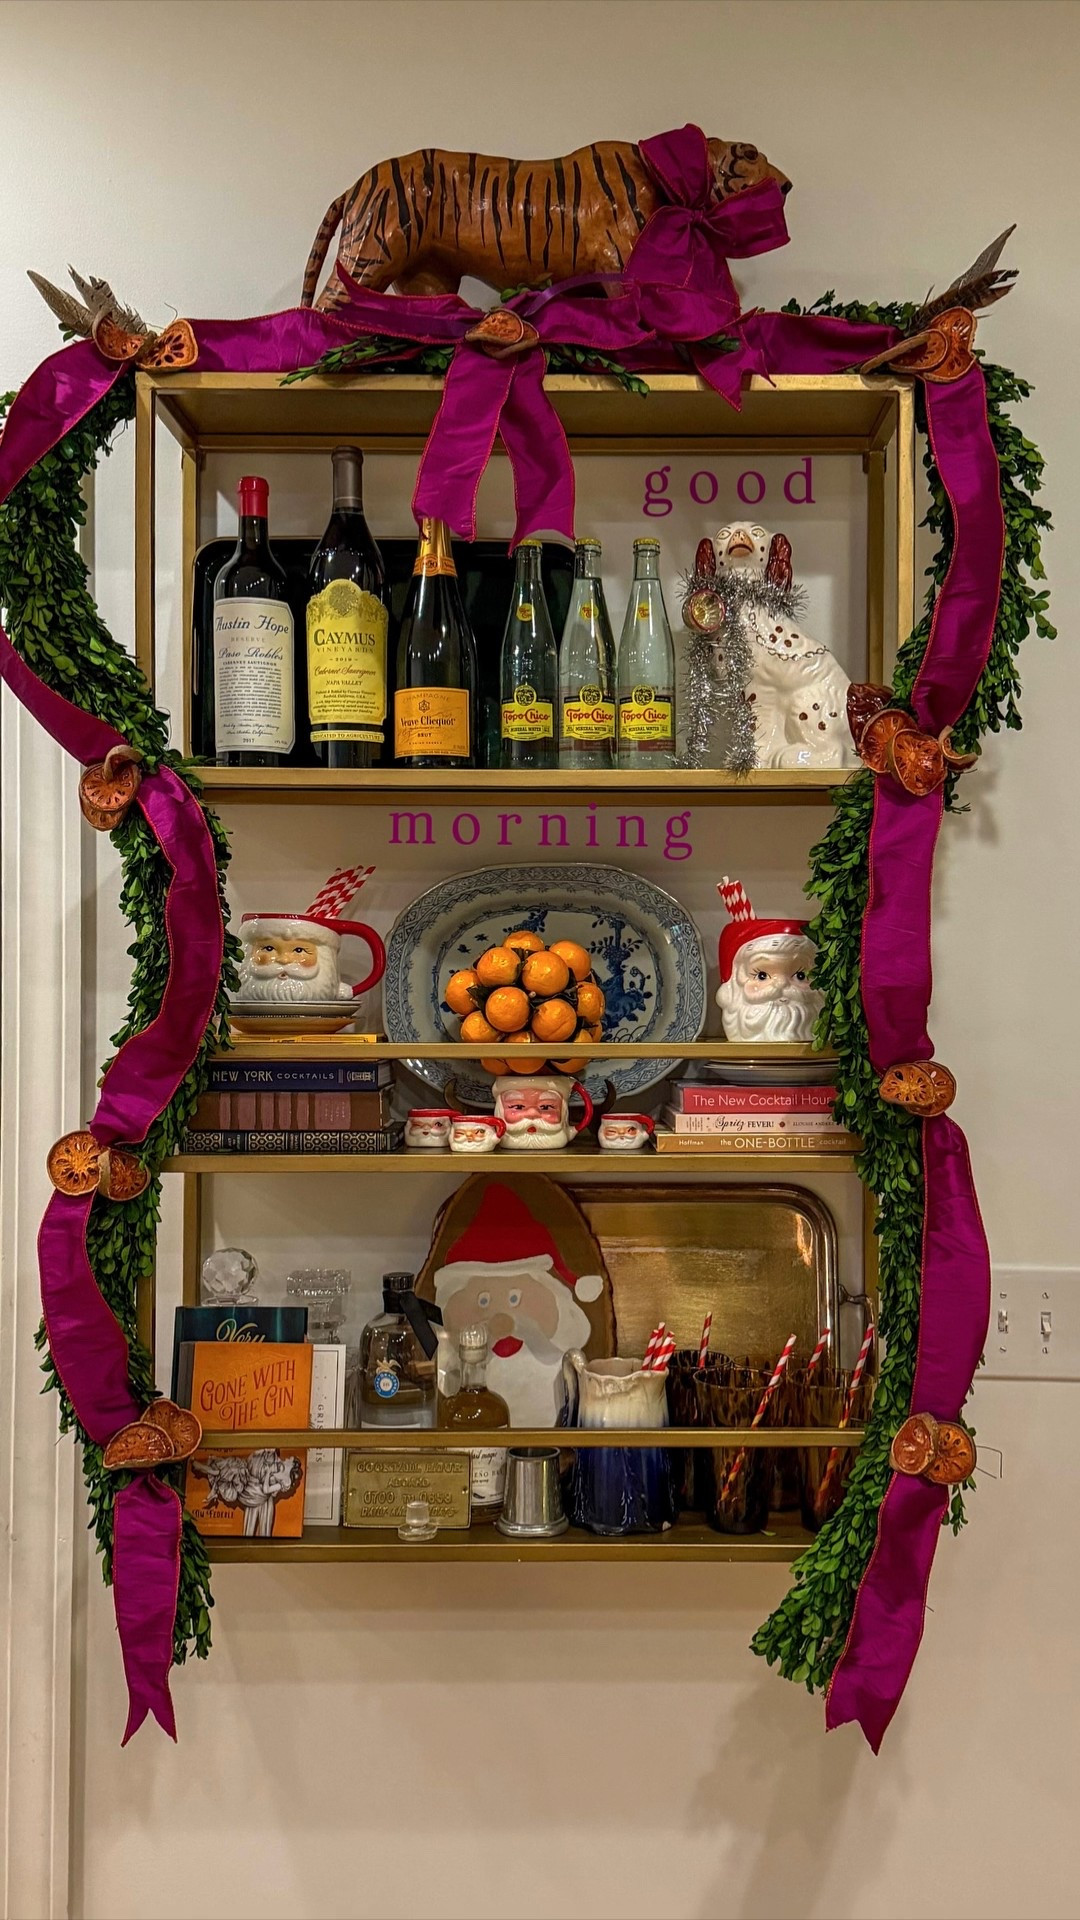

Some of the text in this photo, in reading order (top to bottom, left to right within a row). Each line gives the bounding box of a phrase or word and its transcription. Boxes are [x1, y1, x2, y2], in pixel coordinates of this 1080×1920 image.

[216, 614, 289, 636] Austin Hope
[314, 629, 376, 646] CAYMUS
[218, 646, 283, 660] Paso Robles
[401, 716, 455, 727] Veuve Clicquot
[503, 708, 550, 724] Topo Chico
[566, 708, 613, 723] Topo Chico
[621, 708, 668, 724] Topo Chico
[212, 1070, 239, 1082] NEW
[244, 1070, 273, 1082] YORK
[692, 1094, 831, 1106] The New Cocktail Hour
[714, 1116, 746, 1131] Spritz
[734, 1137, 816, 1149] ONE-BOTTLE
[200, 1360, 295, 1412] GONE WITH
[219, 1384, 294, 1429] THE GIN
[357, 1461, 421, 1473] COCKTAIL
[387, 1476, 430, 1488] ABOARD
[364, 1491, 395, 1504] 0700
